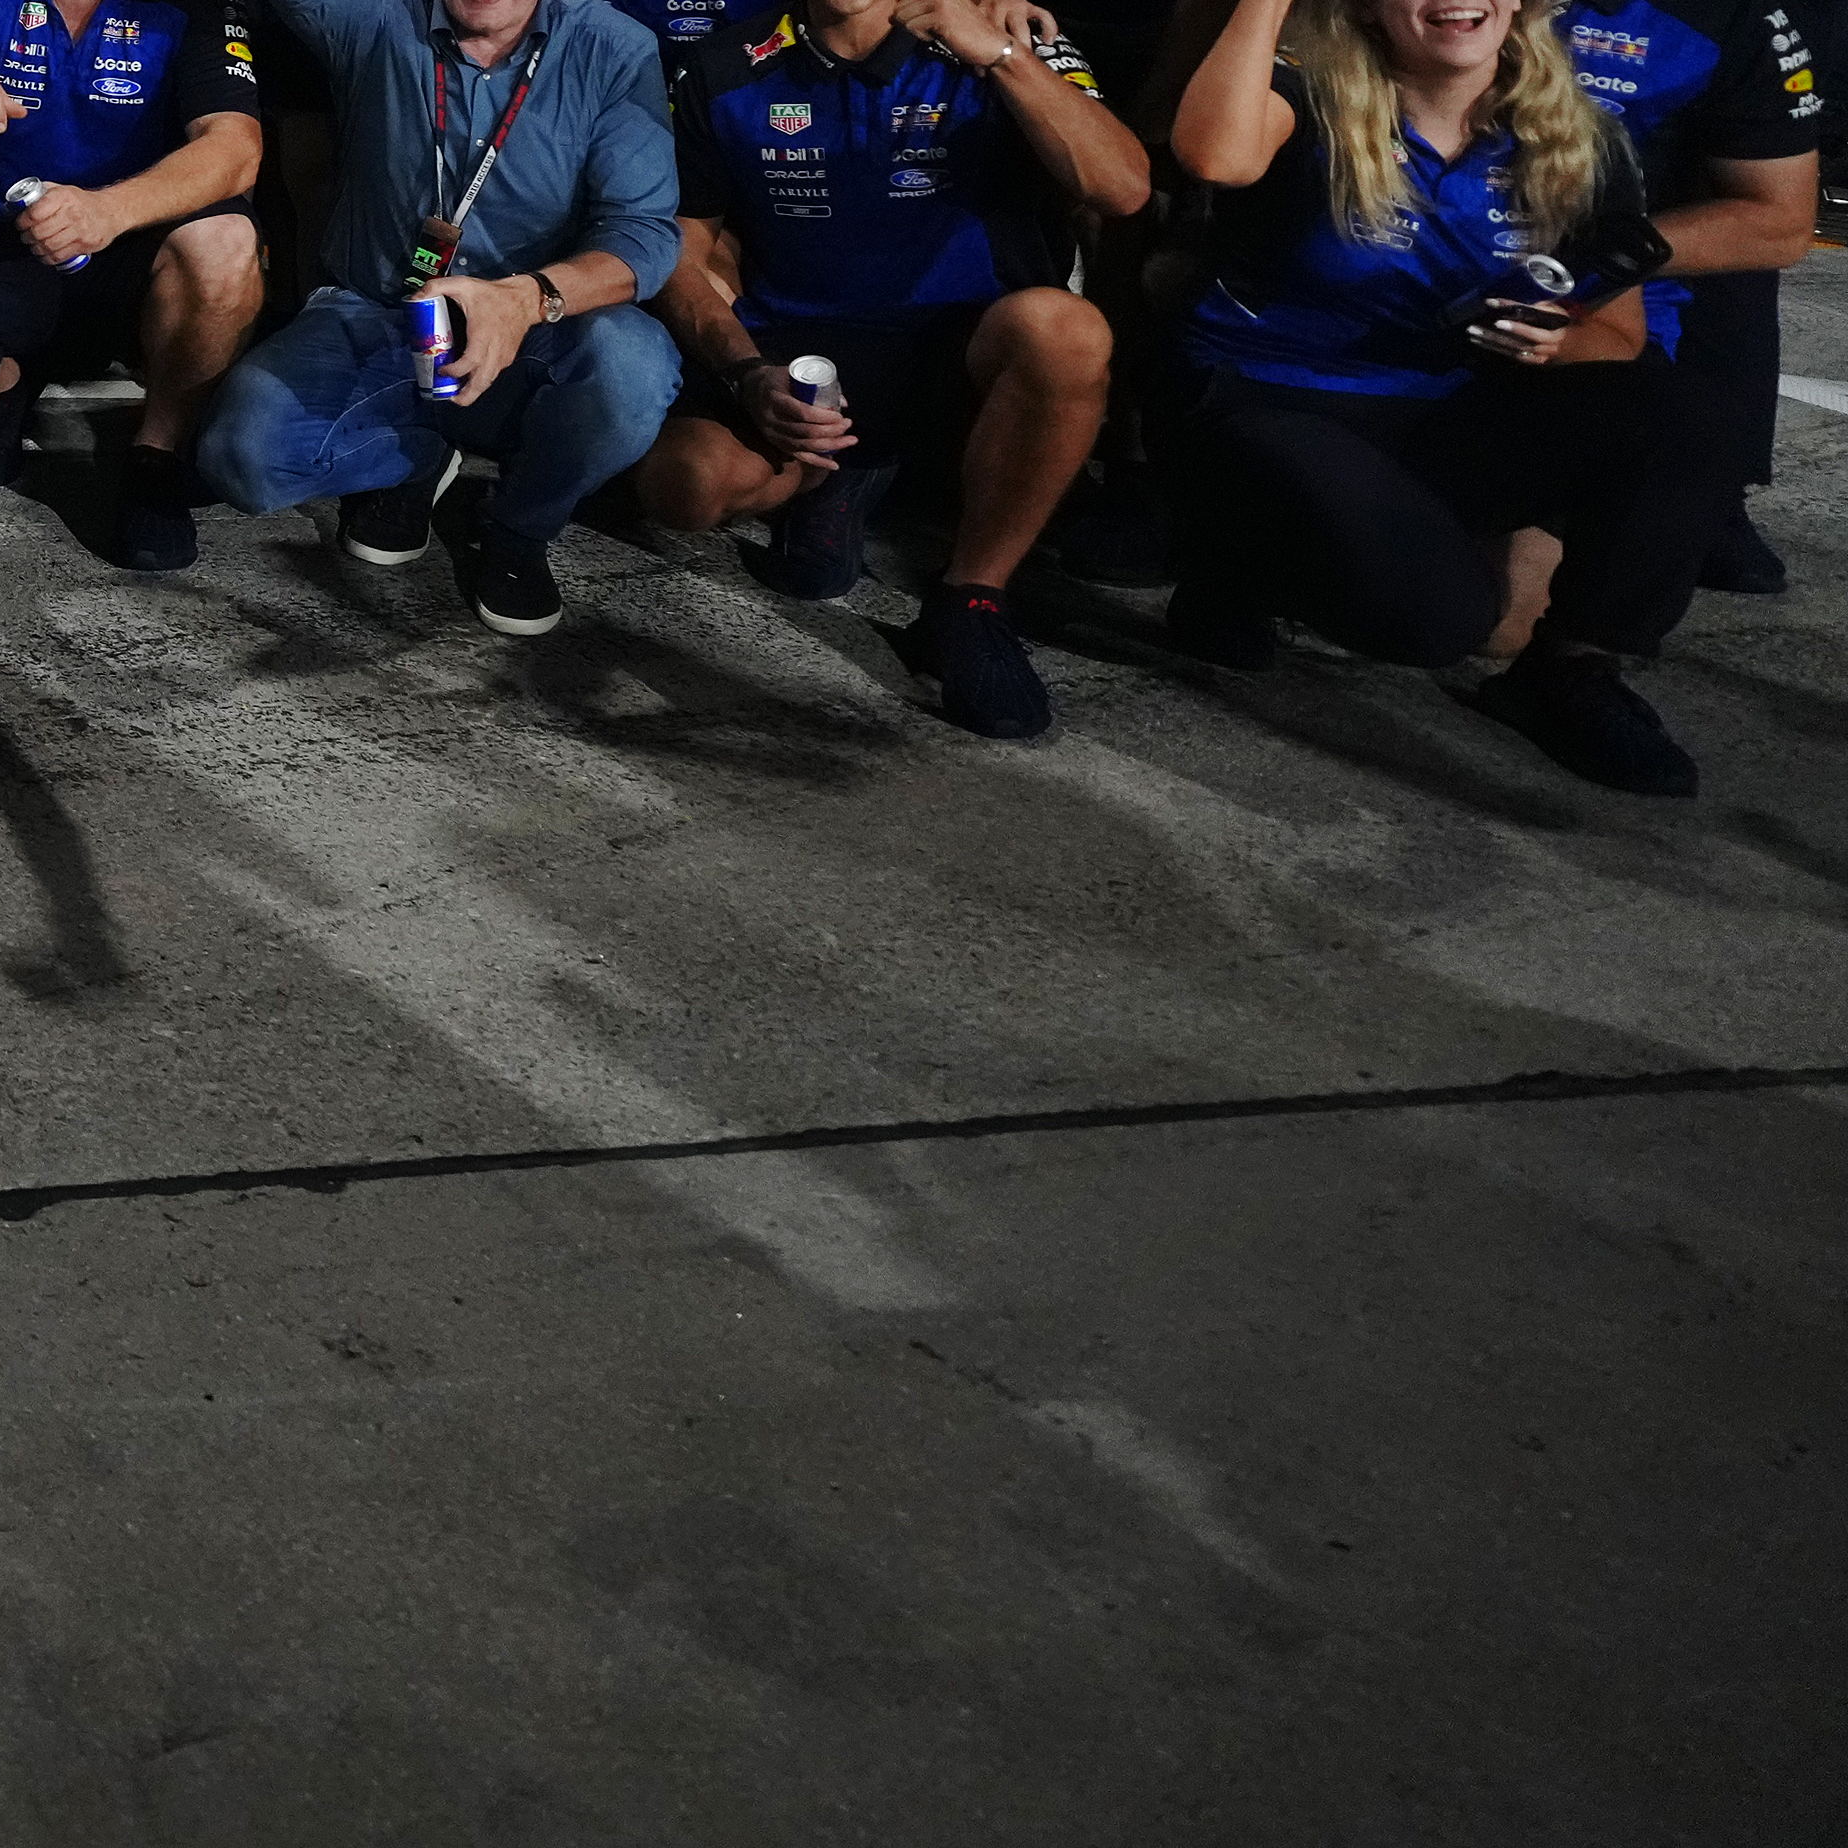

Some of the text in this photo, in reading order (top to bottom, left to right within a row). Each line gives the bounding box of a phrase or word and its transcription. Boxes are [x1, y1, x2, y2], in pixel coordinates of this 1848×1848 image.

[680, 0, 726, 11] Gate
[1571, 24, 1650, 46] ORACLE
[105, 57, 142, 72] Gate
[1577, 72, 1638, 93] Gate
[88, 93, 145, 105] RACING
[772, 104, 808, 116] TAG
[770, 117, 811, 135] HEUER
[763, 169, 826, 179] ORACLE
[768, 187, 830, 198] CARLYLE
